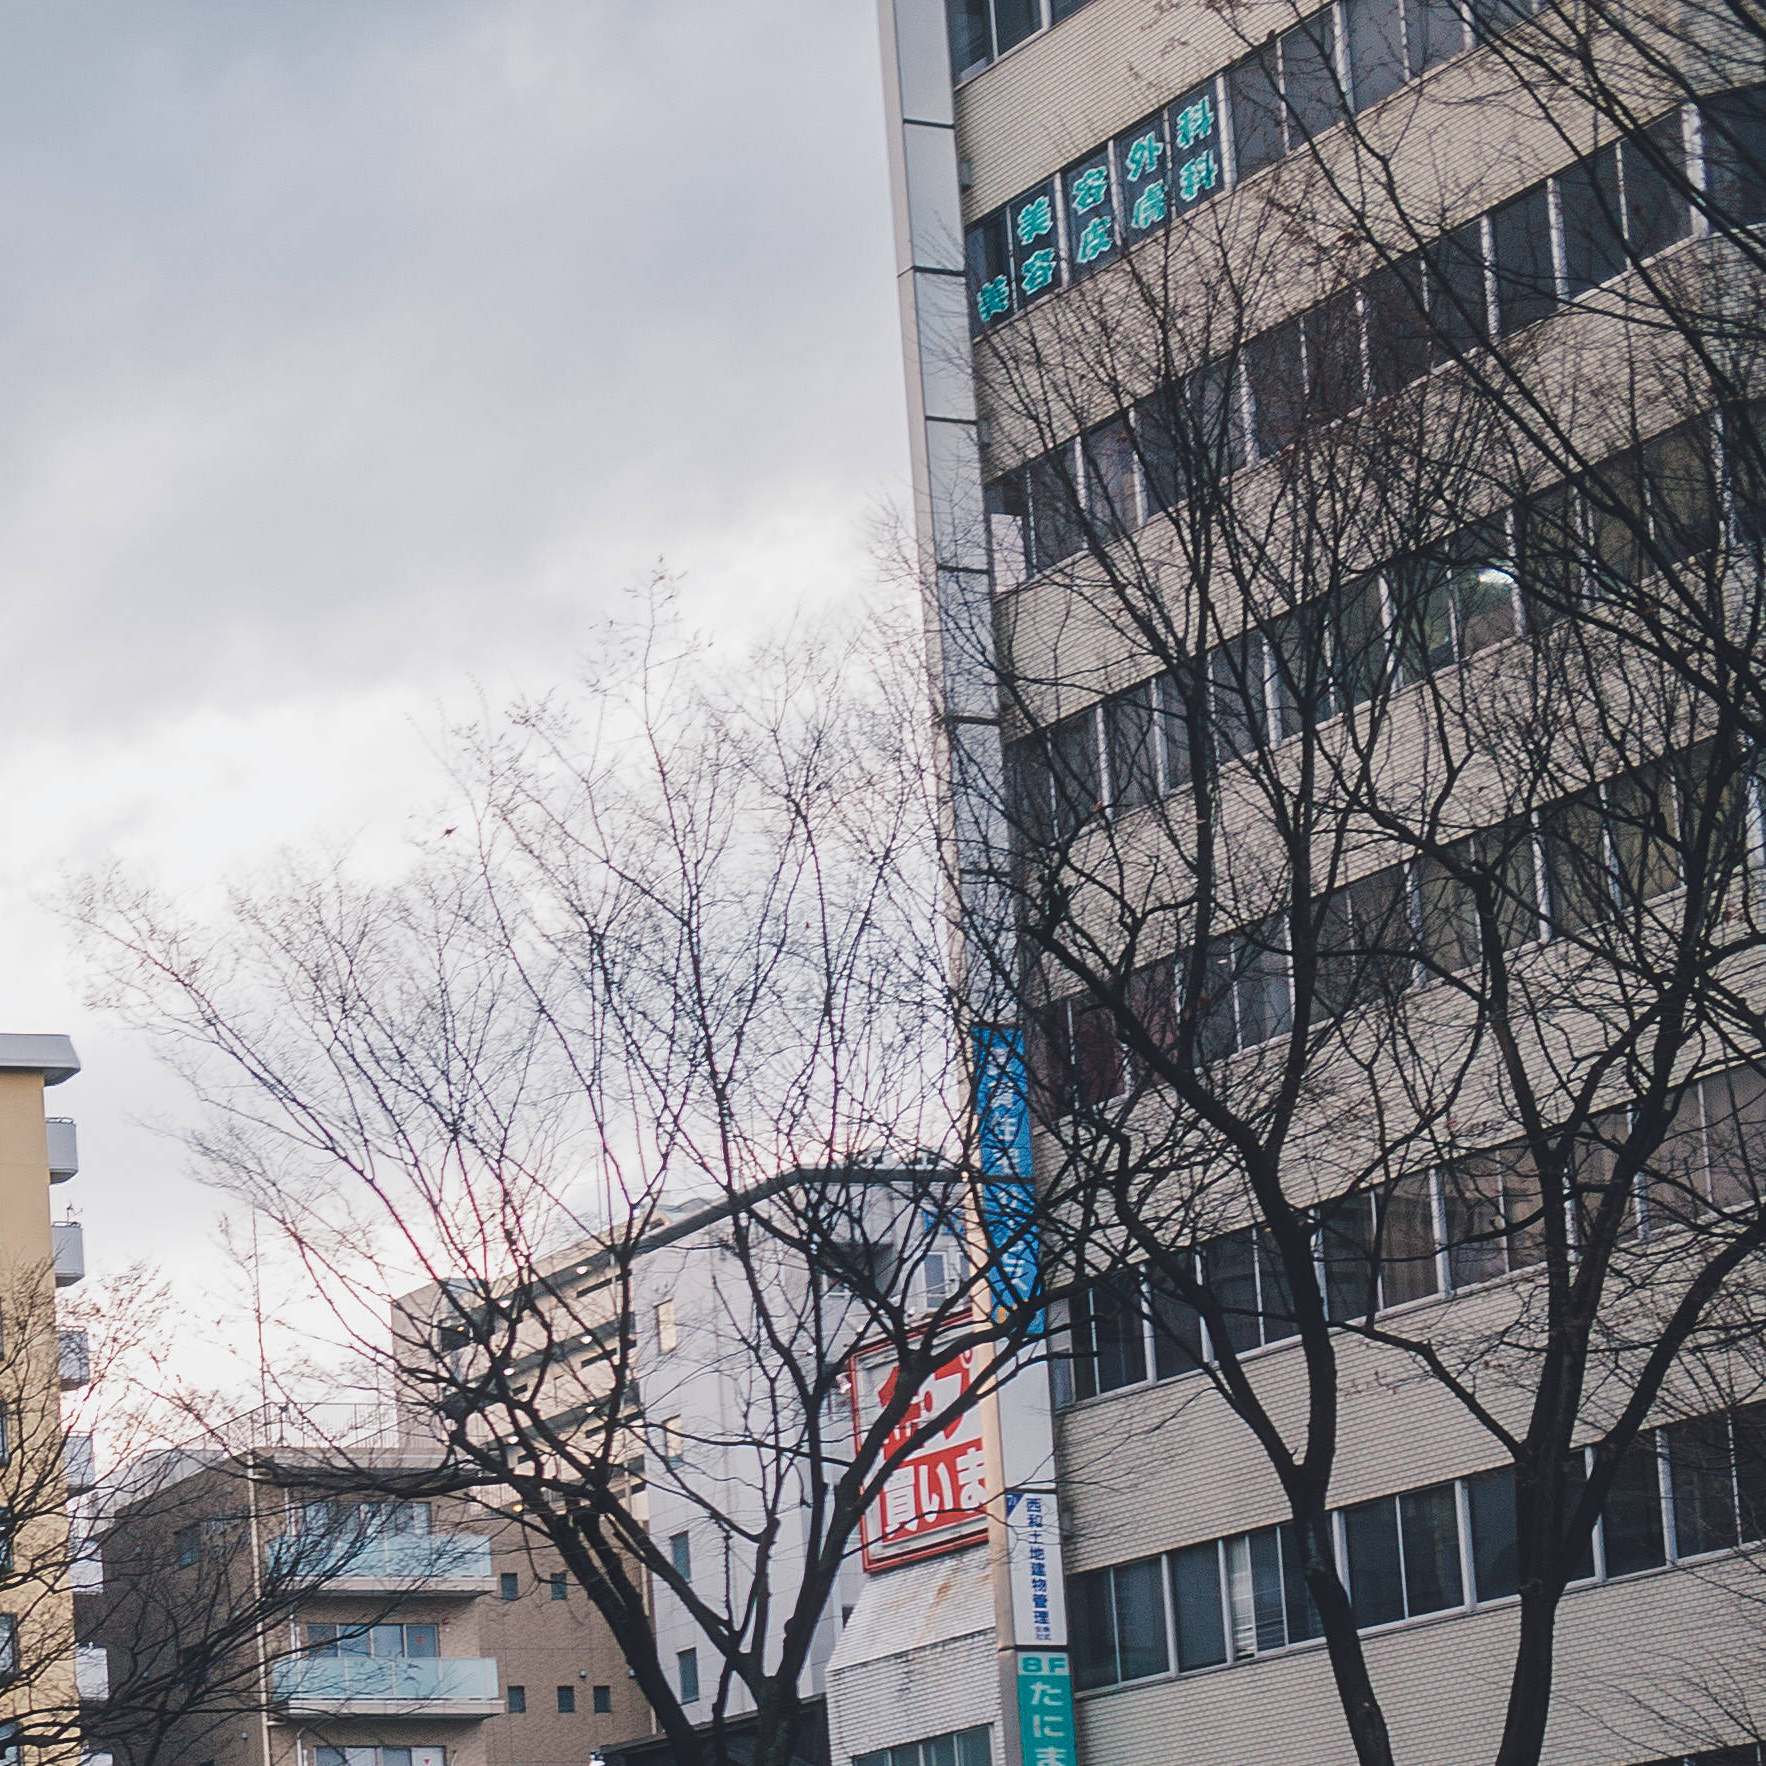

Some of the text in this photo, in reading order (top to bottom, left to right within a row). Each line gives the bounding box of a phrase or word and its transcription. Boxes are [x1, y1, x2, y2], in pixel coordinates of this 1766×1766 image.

[1017, 95, 1215, 246] 美容外科
[1021, 1656, 1068, 1675] 8F
